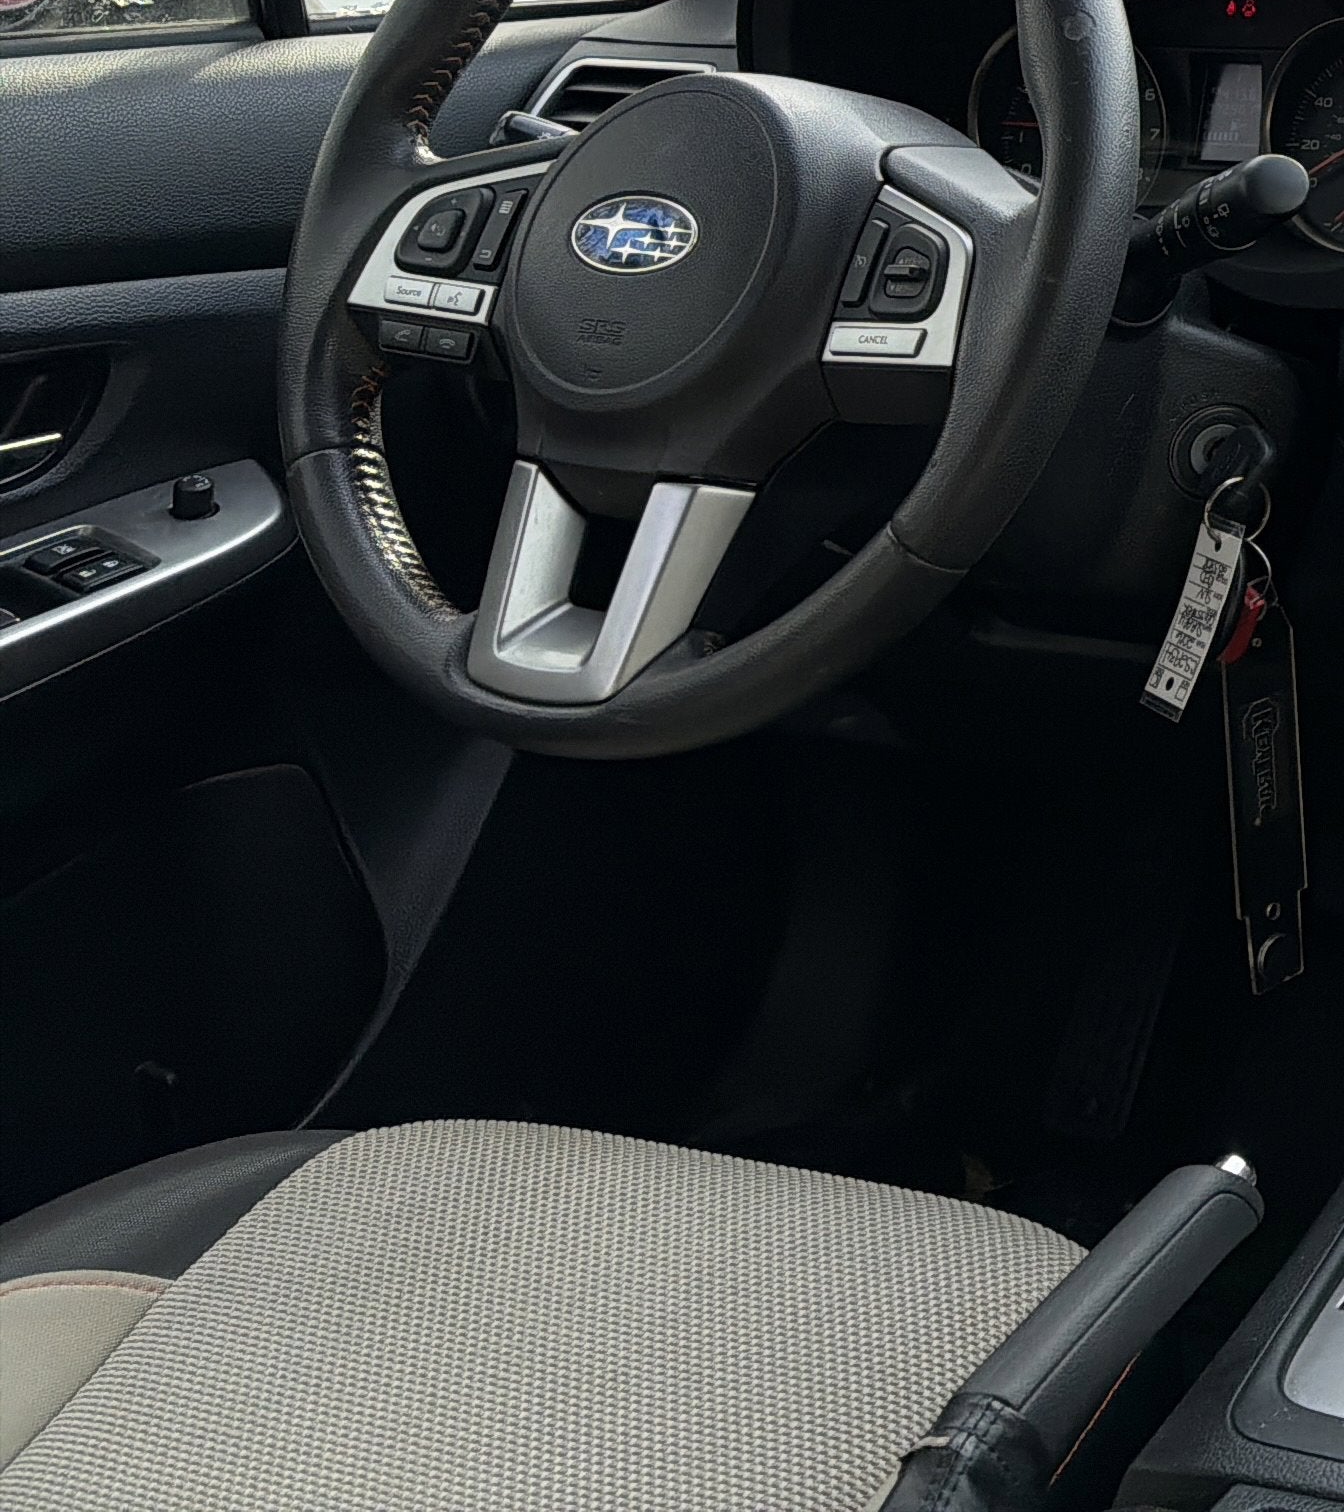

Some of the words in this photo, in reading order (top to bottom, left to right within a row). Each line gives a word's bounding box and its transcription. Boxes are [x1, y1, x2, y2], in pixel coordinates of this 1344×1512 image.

[1144, 89, 1156, 101] 6
[1314, 97, 1334, 108] 40
[1149, 128, 1161, 141] 7
[1300, 139, 1320, 150] 20
[396, 285, 422, 297] Source
[858, 334, 889, 346] CANCEL
